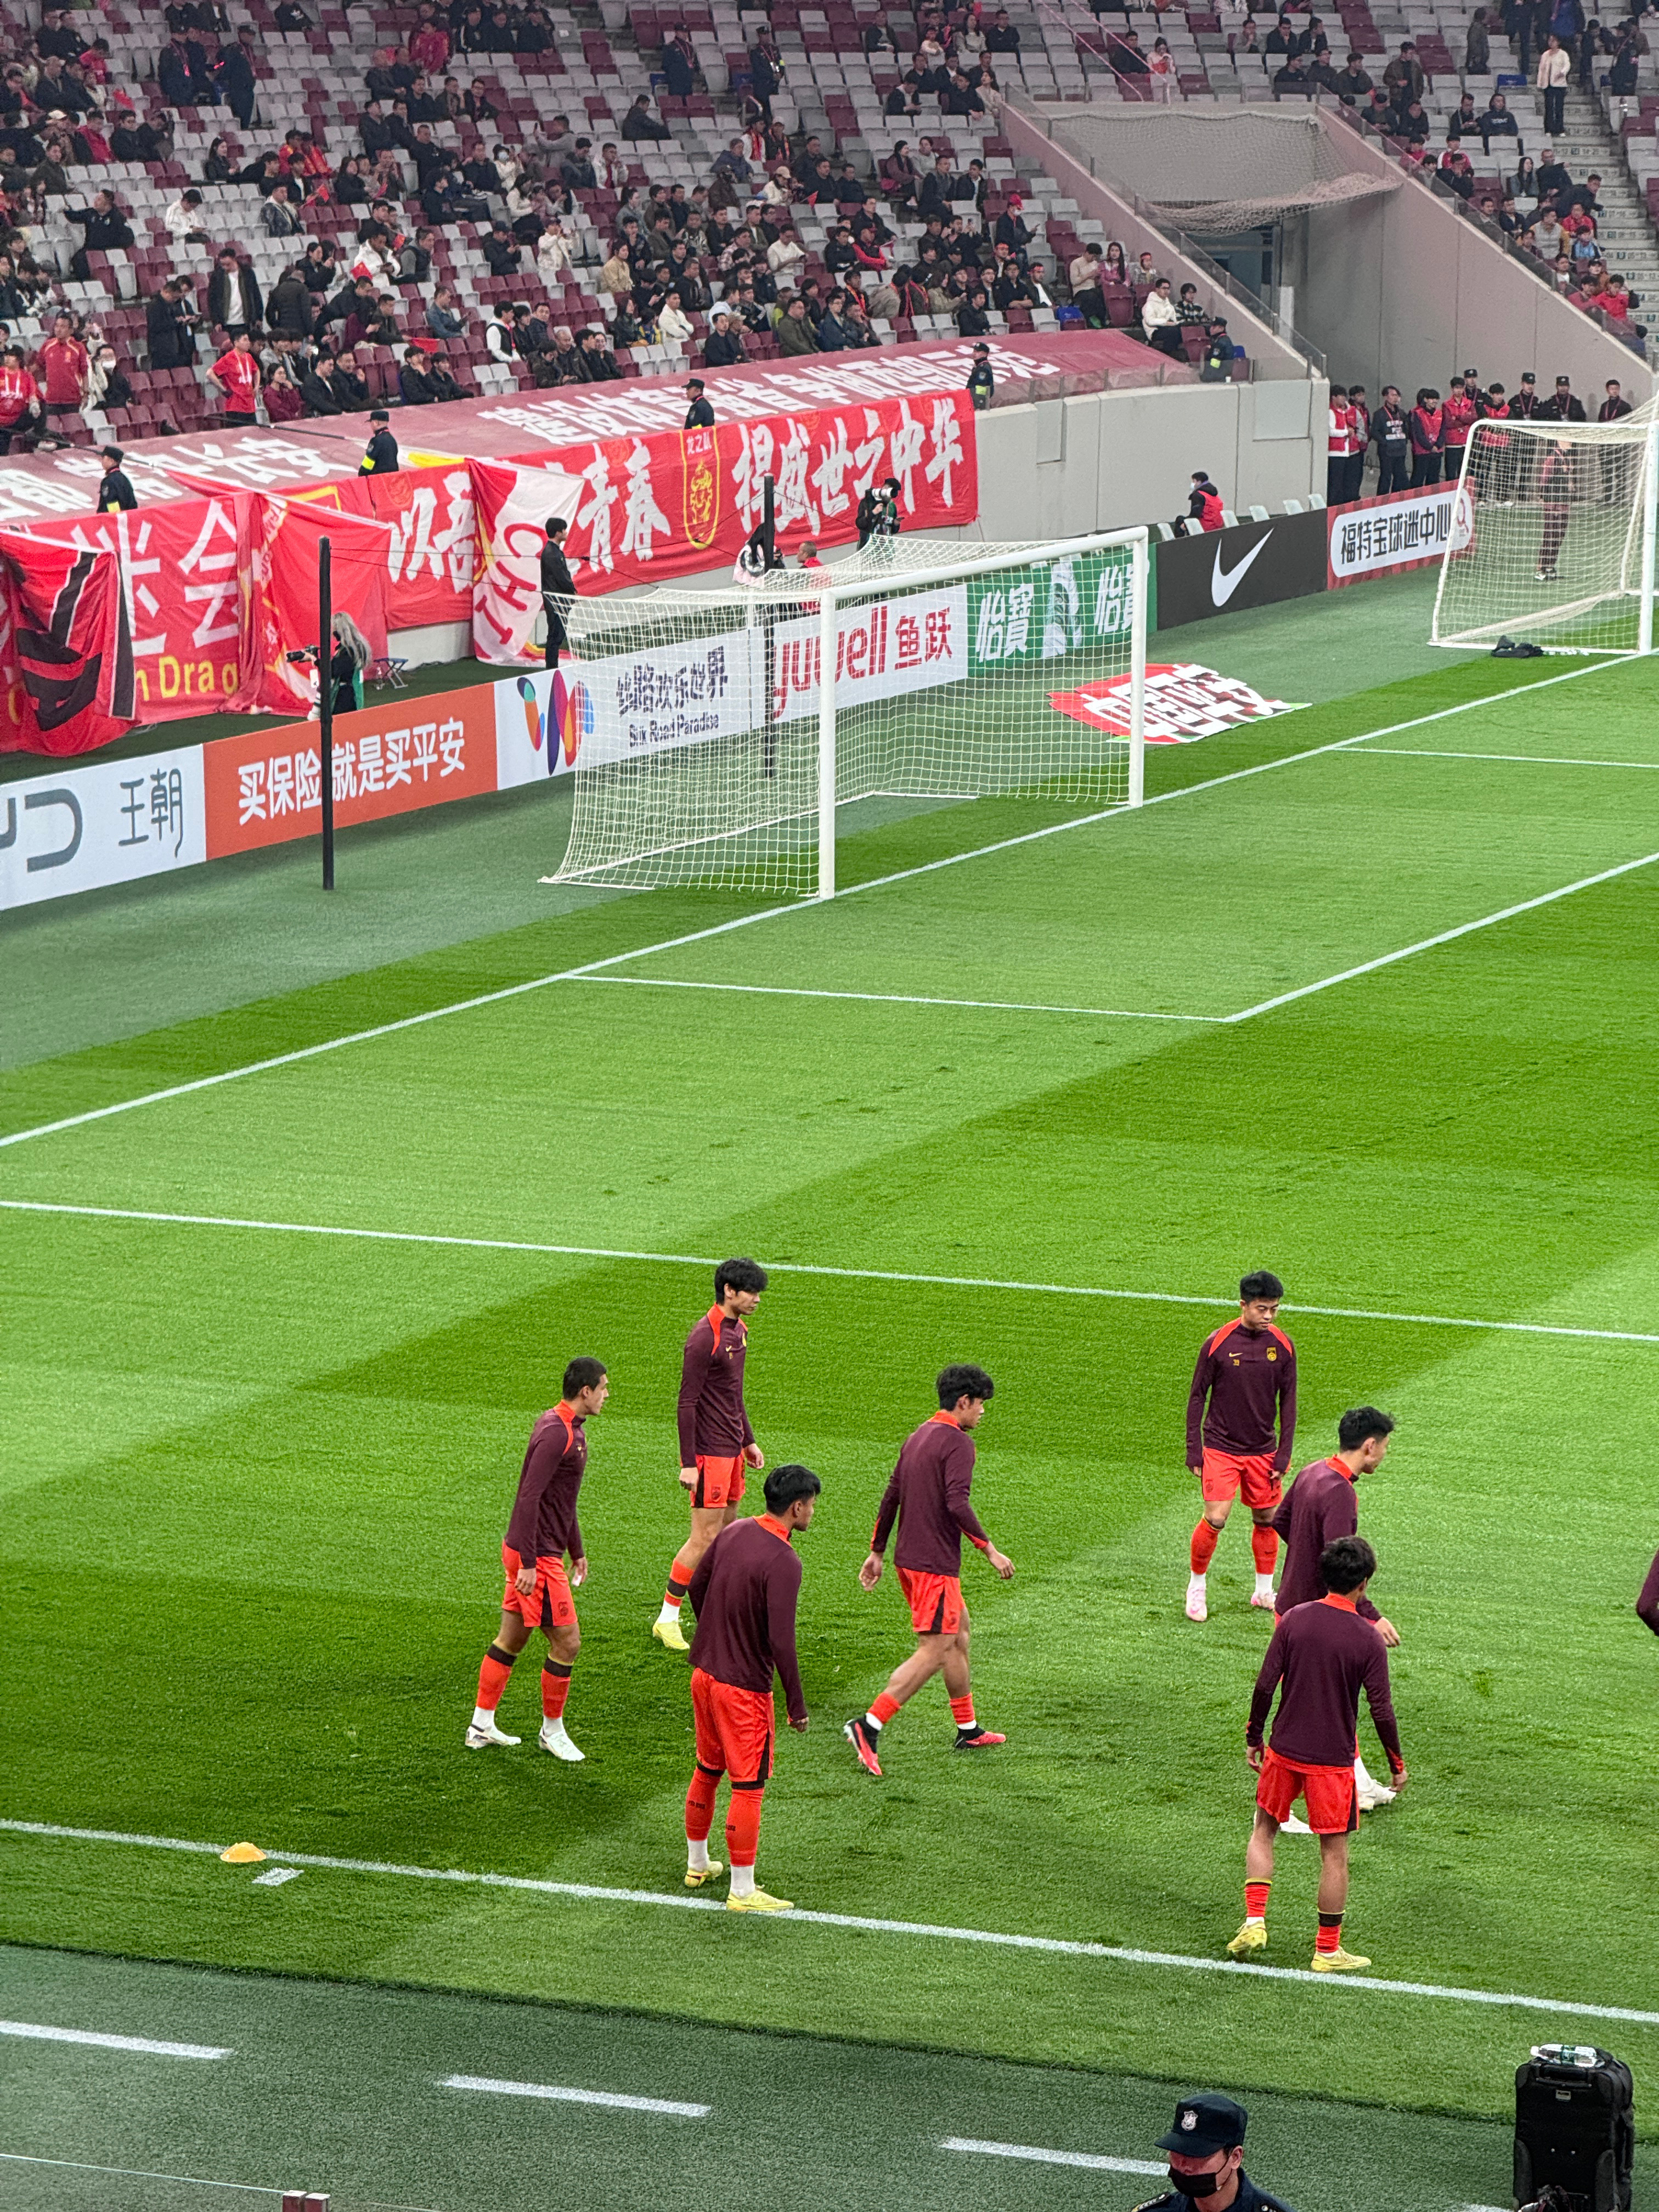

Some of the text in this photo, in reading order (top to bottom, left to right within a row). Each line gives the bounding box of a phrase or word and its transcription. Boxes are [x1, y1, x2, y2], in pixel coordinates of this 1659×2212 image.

[1341, 503, 1452, 565] 福特宝球迷中心
[894, 606, 953, 670] 鱼跃
[650, 720, 675, 743] Road
[676, 711, 719, 738] Paradise
[238, 716, 465, 825] 买保险就是买平安
[119, 768, 183, 859] 王朝
